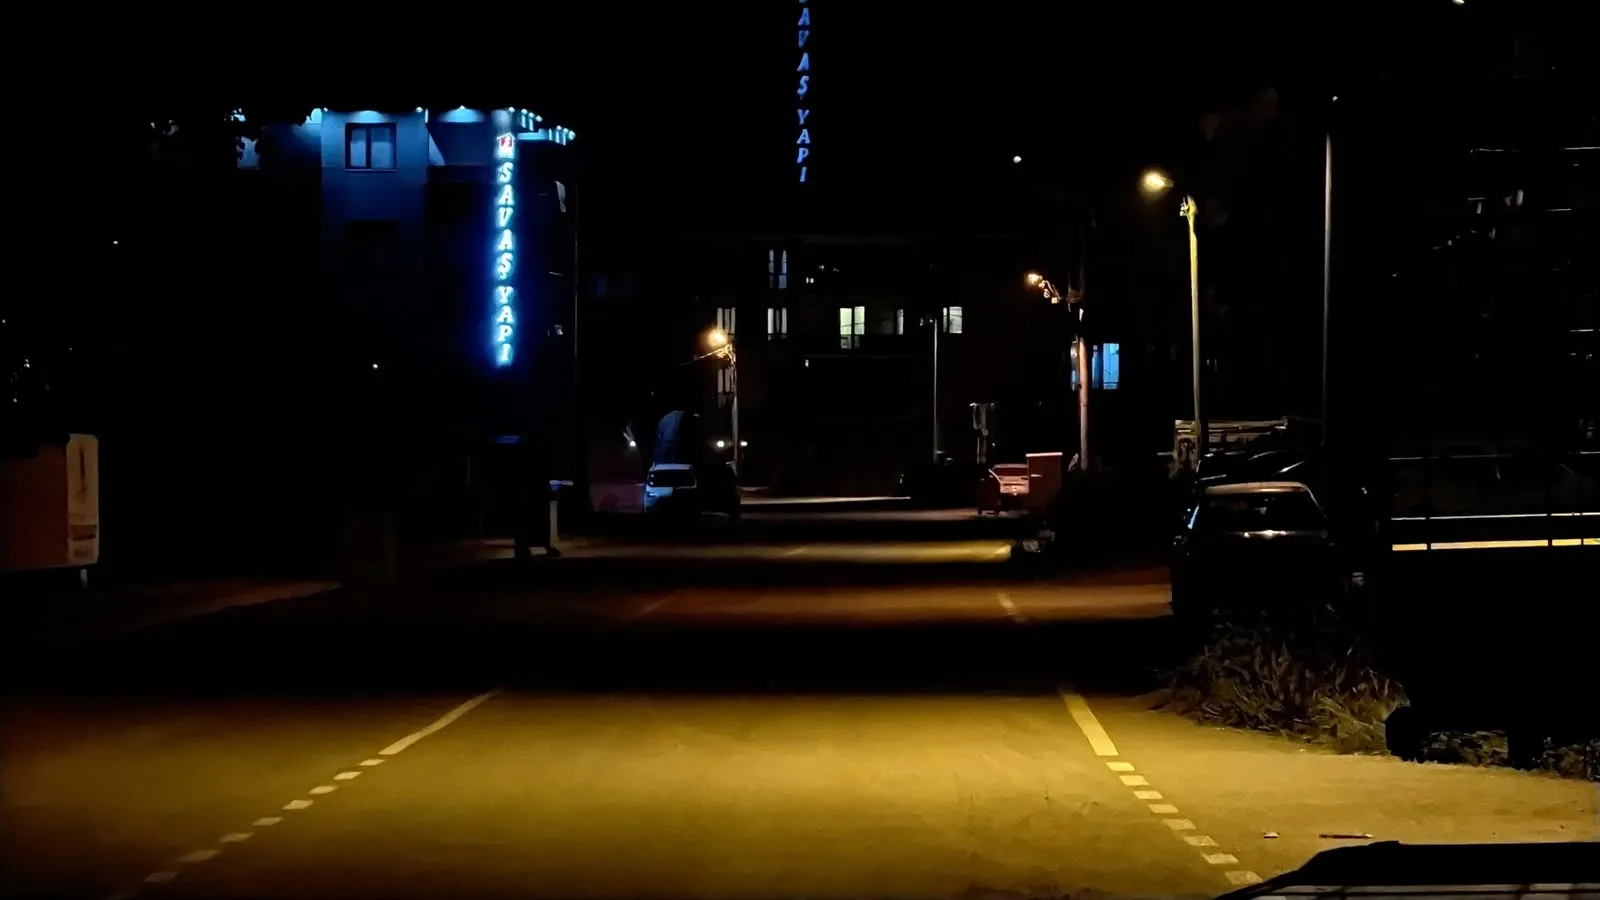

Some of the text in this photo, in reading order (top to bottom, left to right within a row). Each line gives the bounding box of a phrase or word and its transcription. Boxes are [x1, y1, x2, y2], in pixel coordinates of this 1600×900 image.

[797, 0, 810, 182] AVAŞ YAPI
[496, 161, 515, 365] SAVAŞ YAPI
